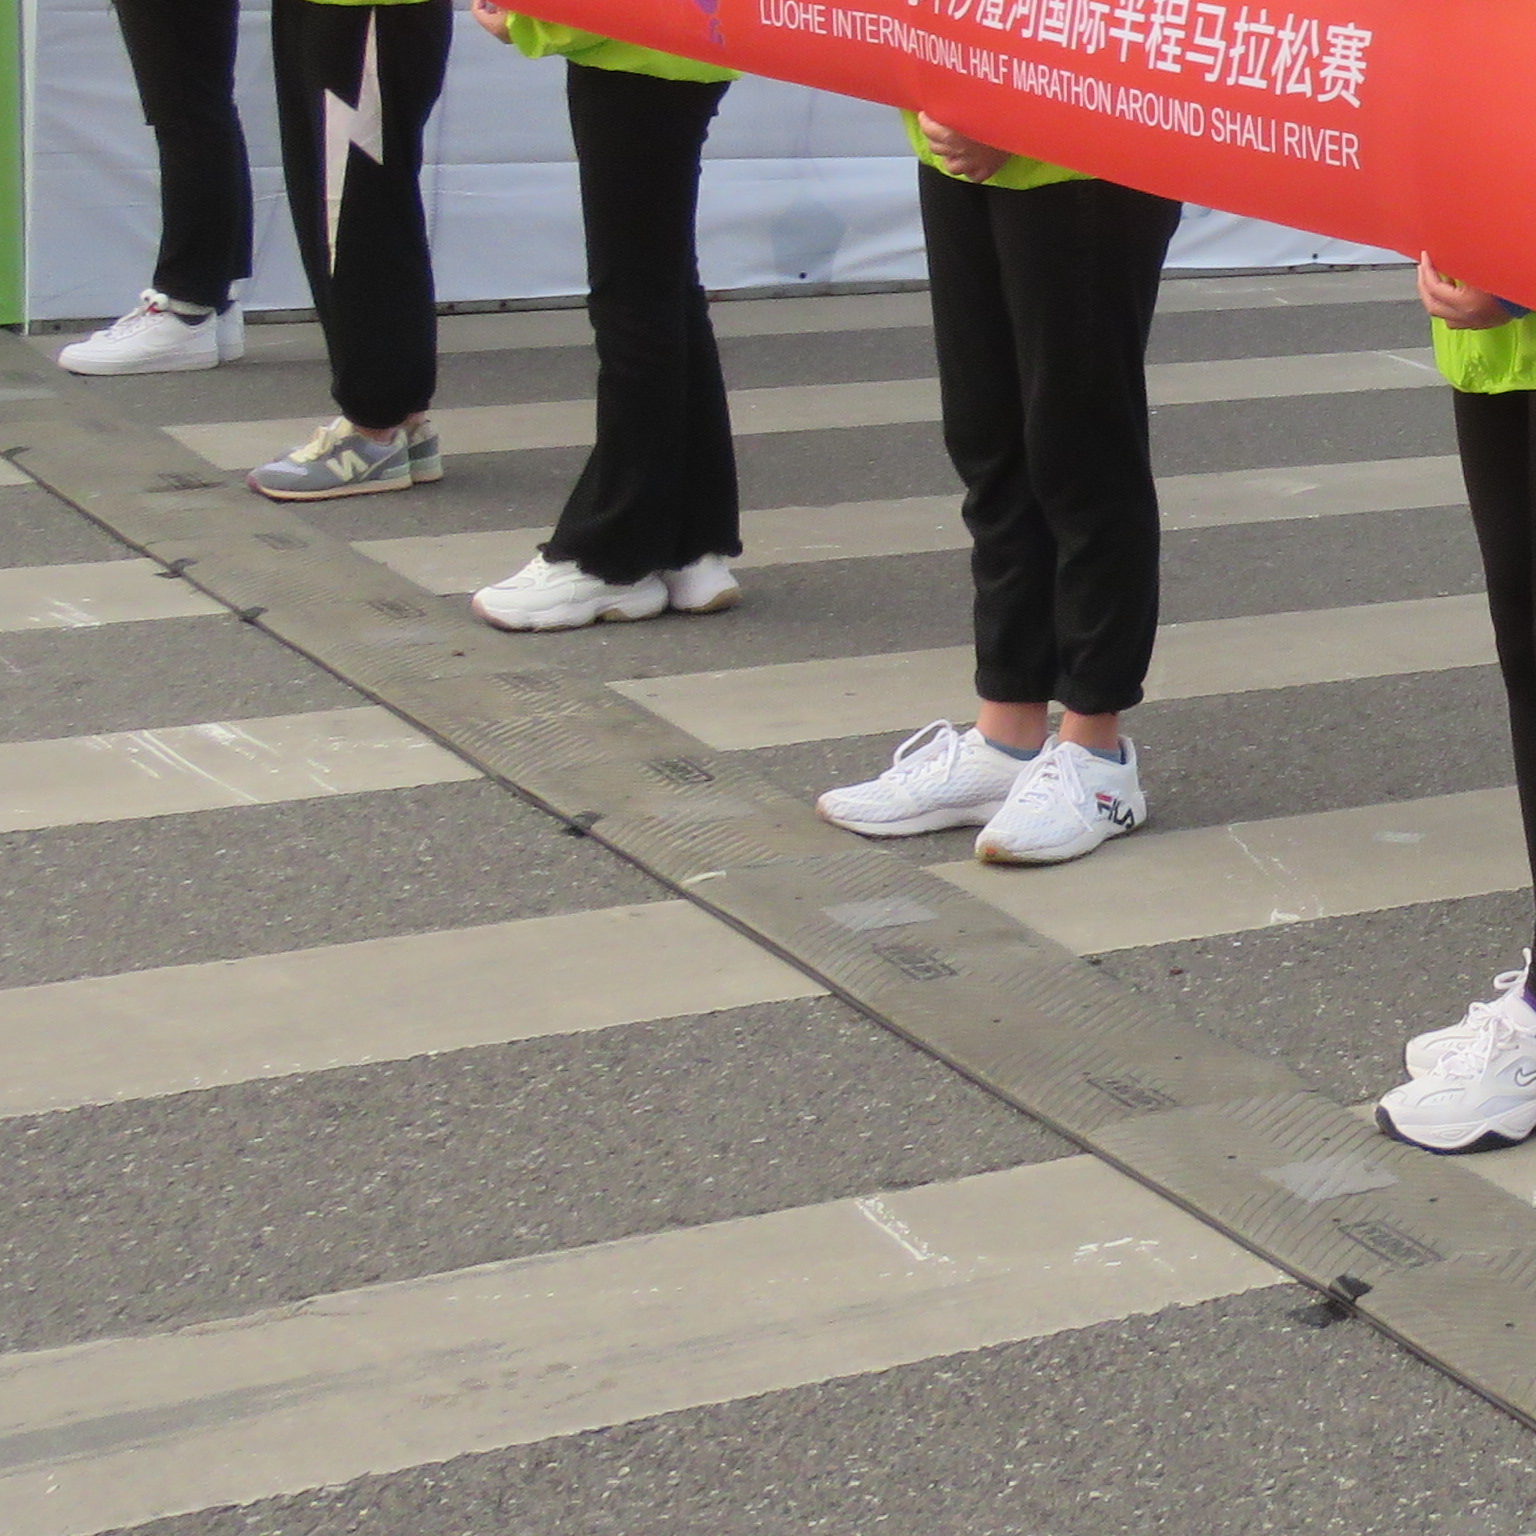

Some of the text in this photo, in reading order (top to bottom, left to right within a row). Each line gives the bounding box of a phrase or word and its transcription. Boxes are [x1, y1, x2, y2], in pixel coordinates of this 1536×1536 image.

[831, 8, 967, 75] INTERNATIONAL
[969, 46, 1009, 85] HALF
[1013, 58, 1112, 115] MARATHON
[1115, 86, 1205, 138] AROUND
[1211, 107, 1276, 154] SHALI
[1283, 121, 1361, 170] RIVER
